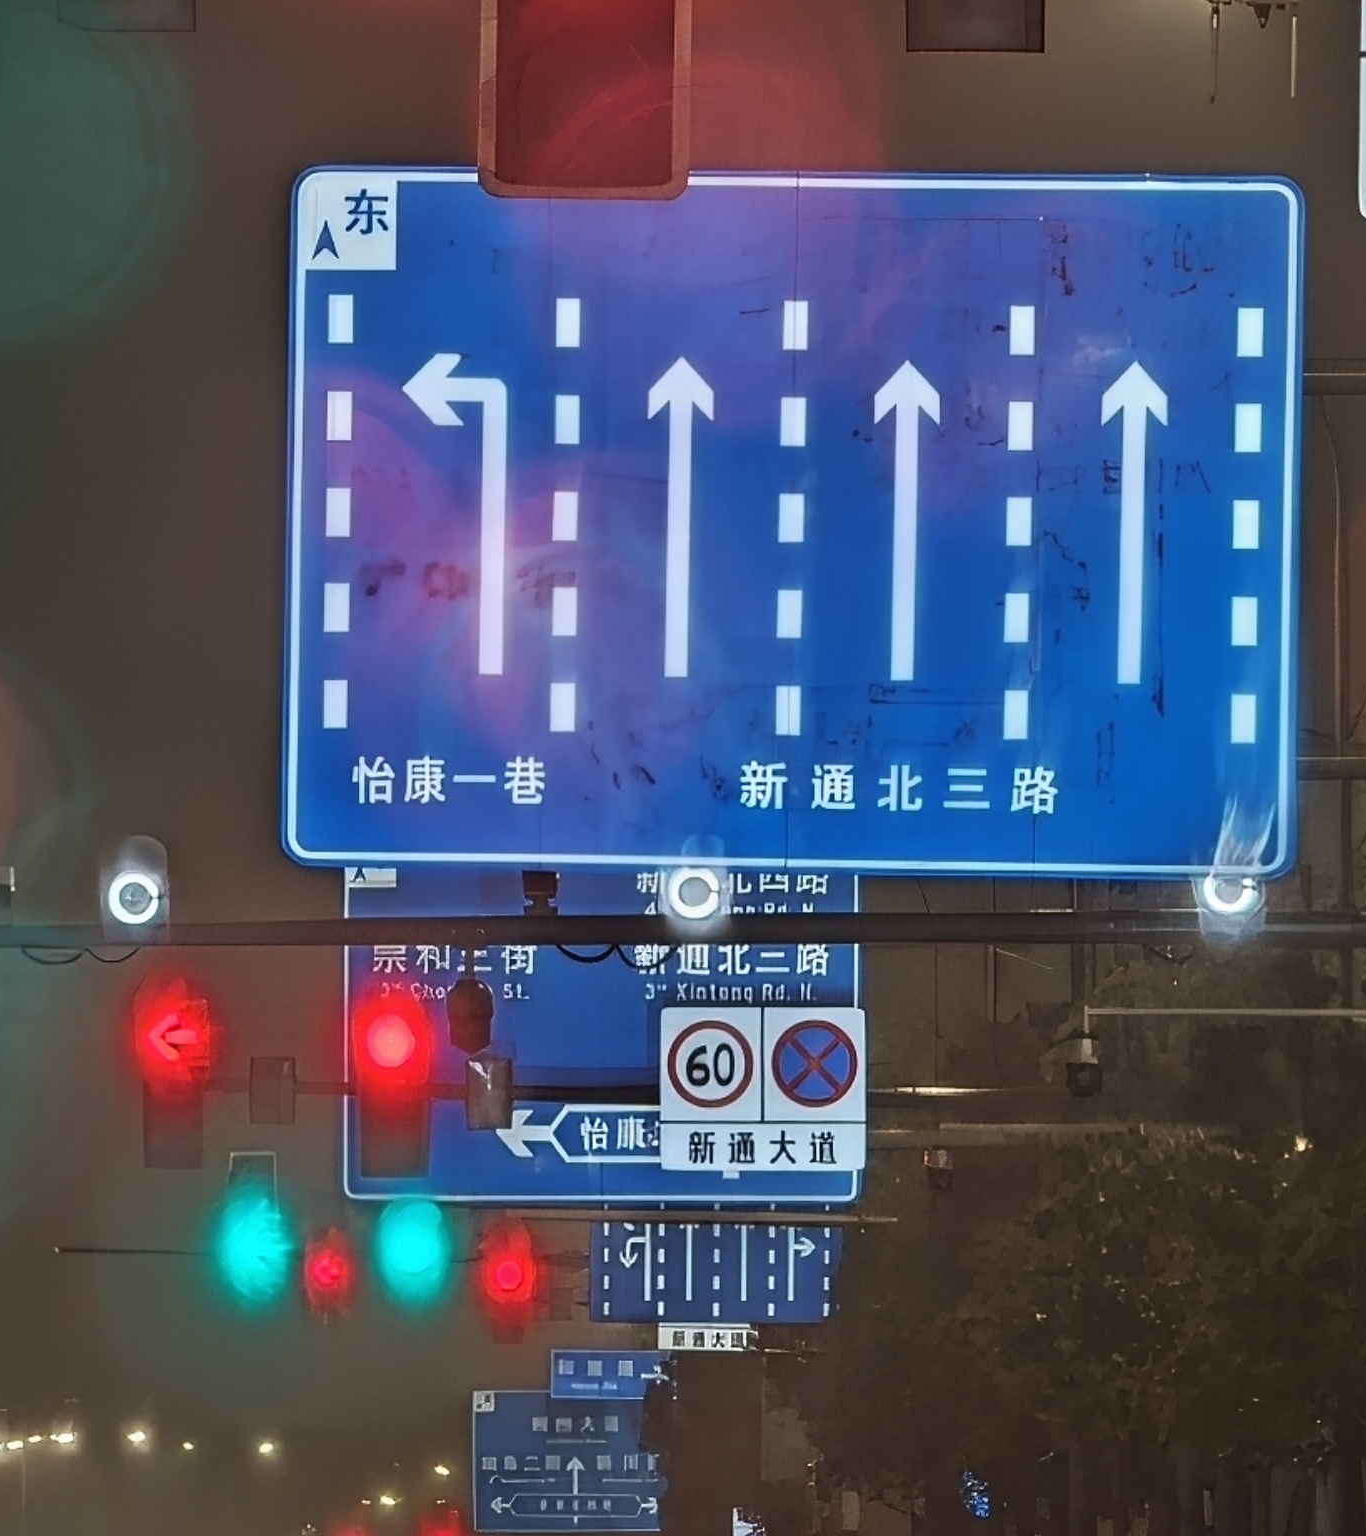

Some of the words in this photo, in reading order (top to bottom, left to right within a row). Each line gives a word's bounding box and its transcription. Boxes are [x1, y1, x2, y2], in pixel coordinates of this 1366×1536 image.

[344, 190, 389, 235] 东
[352, 756, 547, 804] 怡康一巷
[739, 761, 1058, 816] 新通北三路
[685, 1042, 736, 1088] 60
[580, 1115, 660, 1151] 怡康
[689, 1130, 837, 1165] 新通大道
